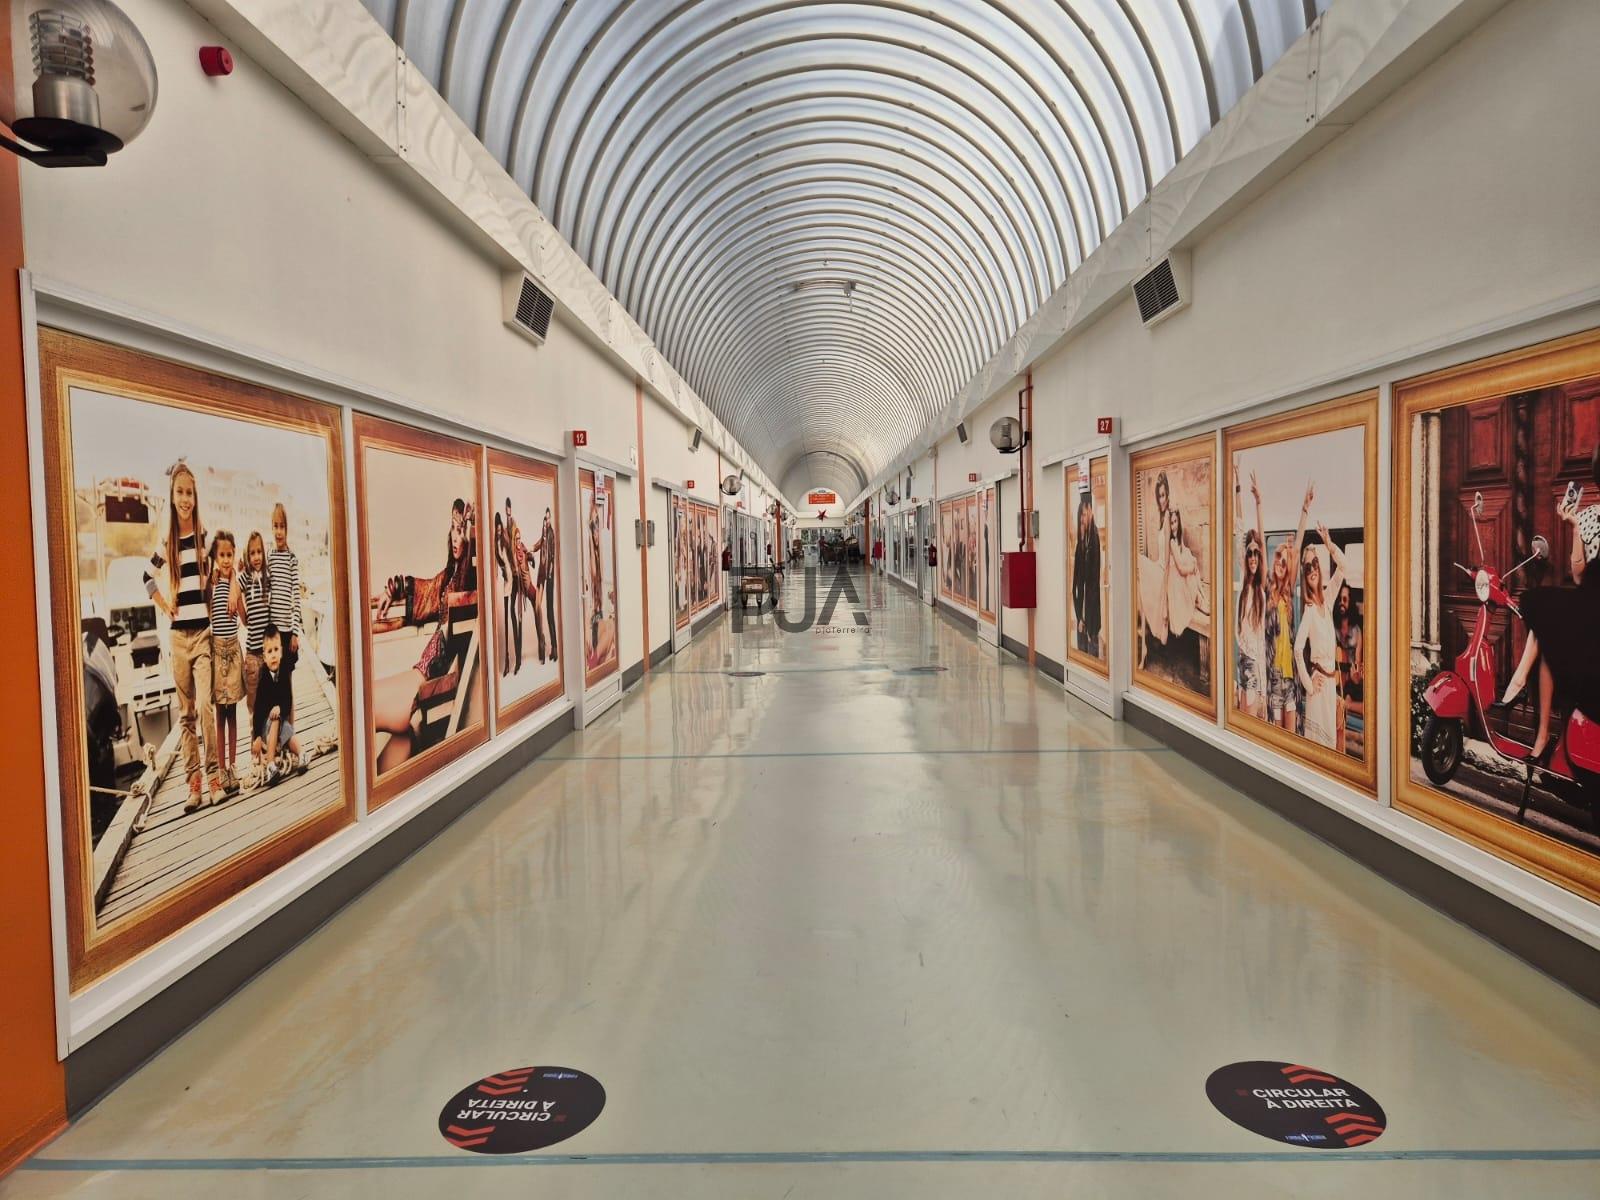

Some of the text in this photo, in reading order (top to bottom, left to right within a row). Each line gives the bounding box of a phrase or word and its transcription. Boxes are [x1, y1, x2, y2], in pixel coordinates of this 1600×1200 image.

[1099, 420, 1110, 431] 27
[576, 433, 585, 444] 12
[1252, 1088, 1350, 1099] CIRCULAR
[468, 1099, 556, 1112] À DIREITA
[1266, 1098, 1360, 1109] À DIREITA
[457, 1109, 551, 1121] CIRCULAR
